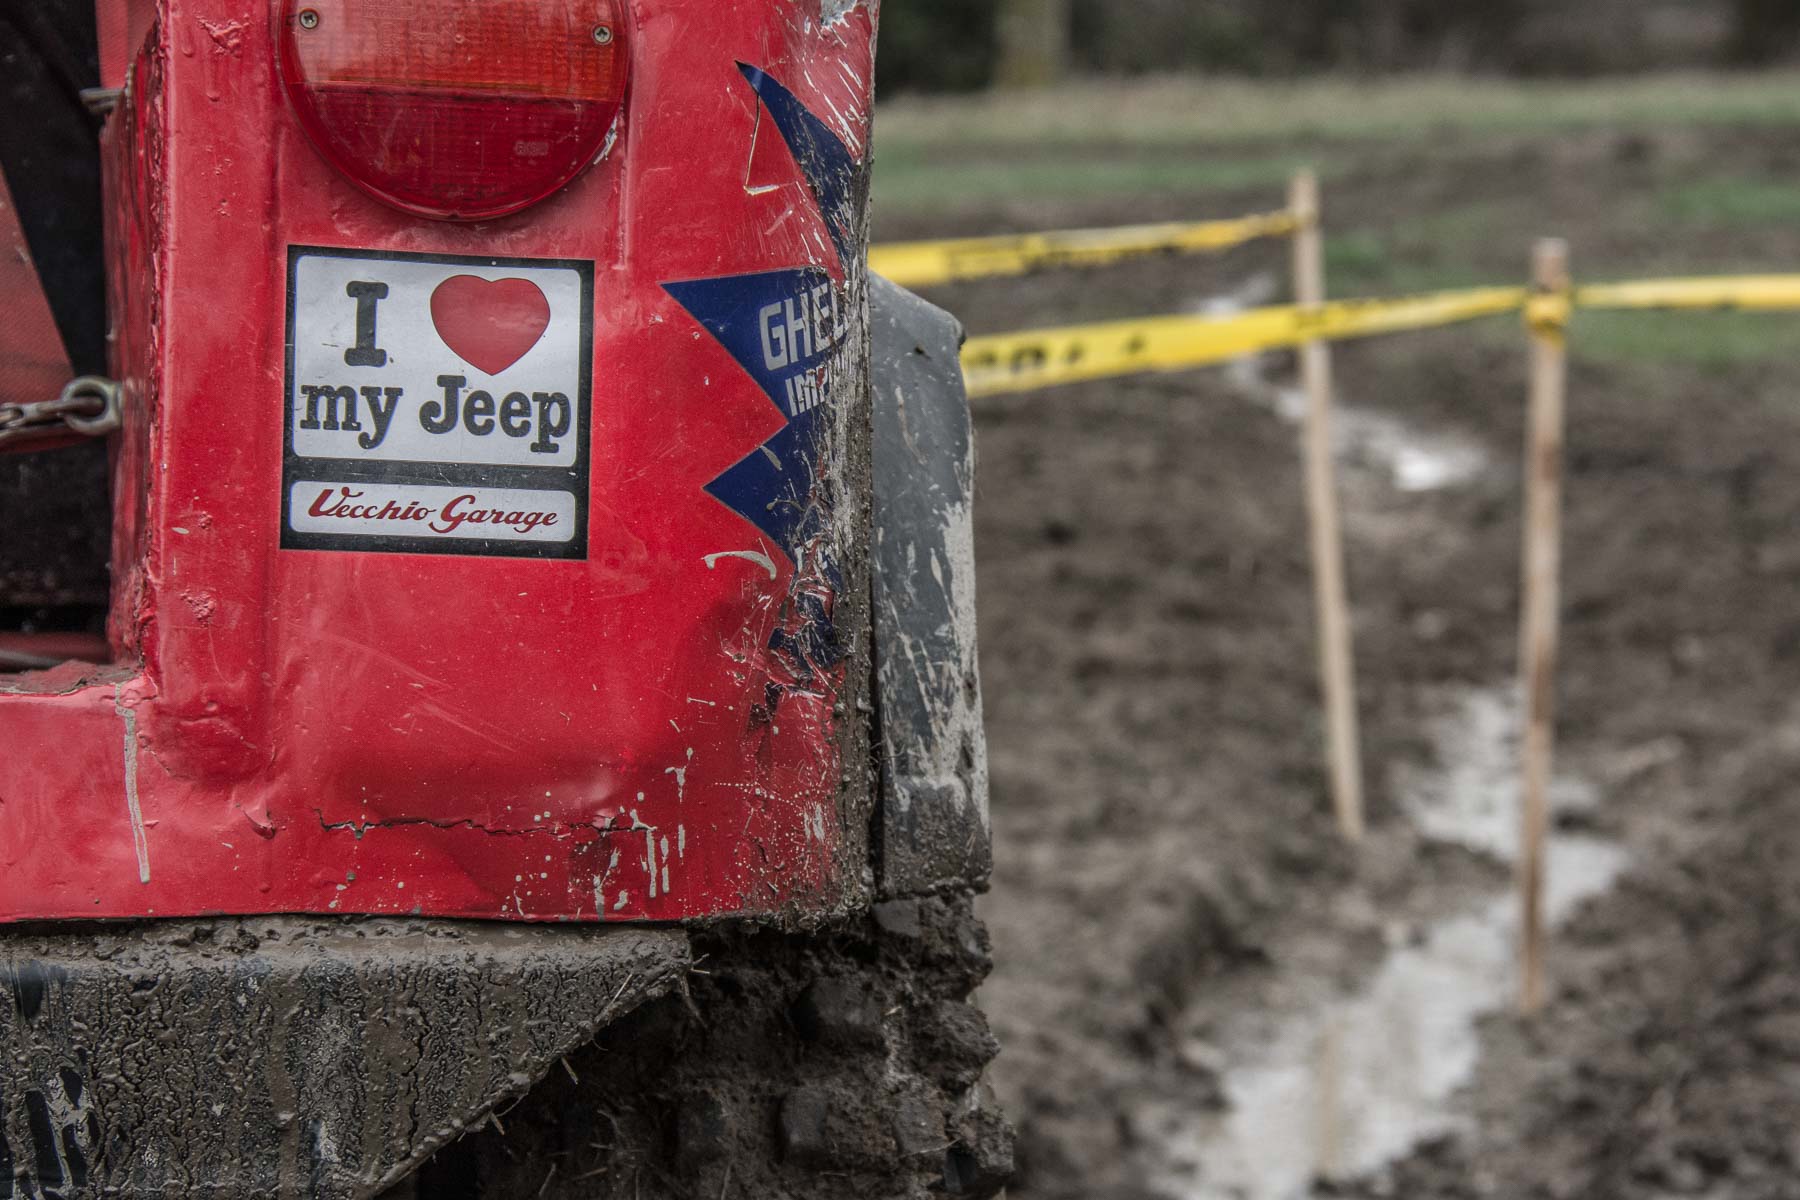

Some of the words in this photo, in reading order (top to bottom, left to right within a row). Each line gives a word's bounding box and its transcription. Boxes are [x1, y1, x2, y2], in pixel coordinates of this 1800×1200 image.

[344, 280, 389, 368] I
[300, 384, 404, 450] my
[419, 374, 572, 454] Jeep
[308, 486, 436, 521] Vecchio
[428, 494, 559, 534] Garage
